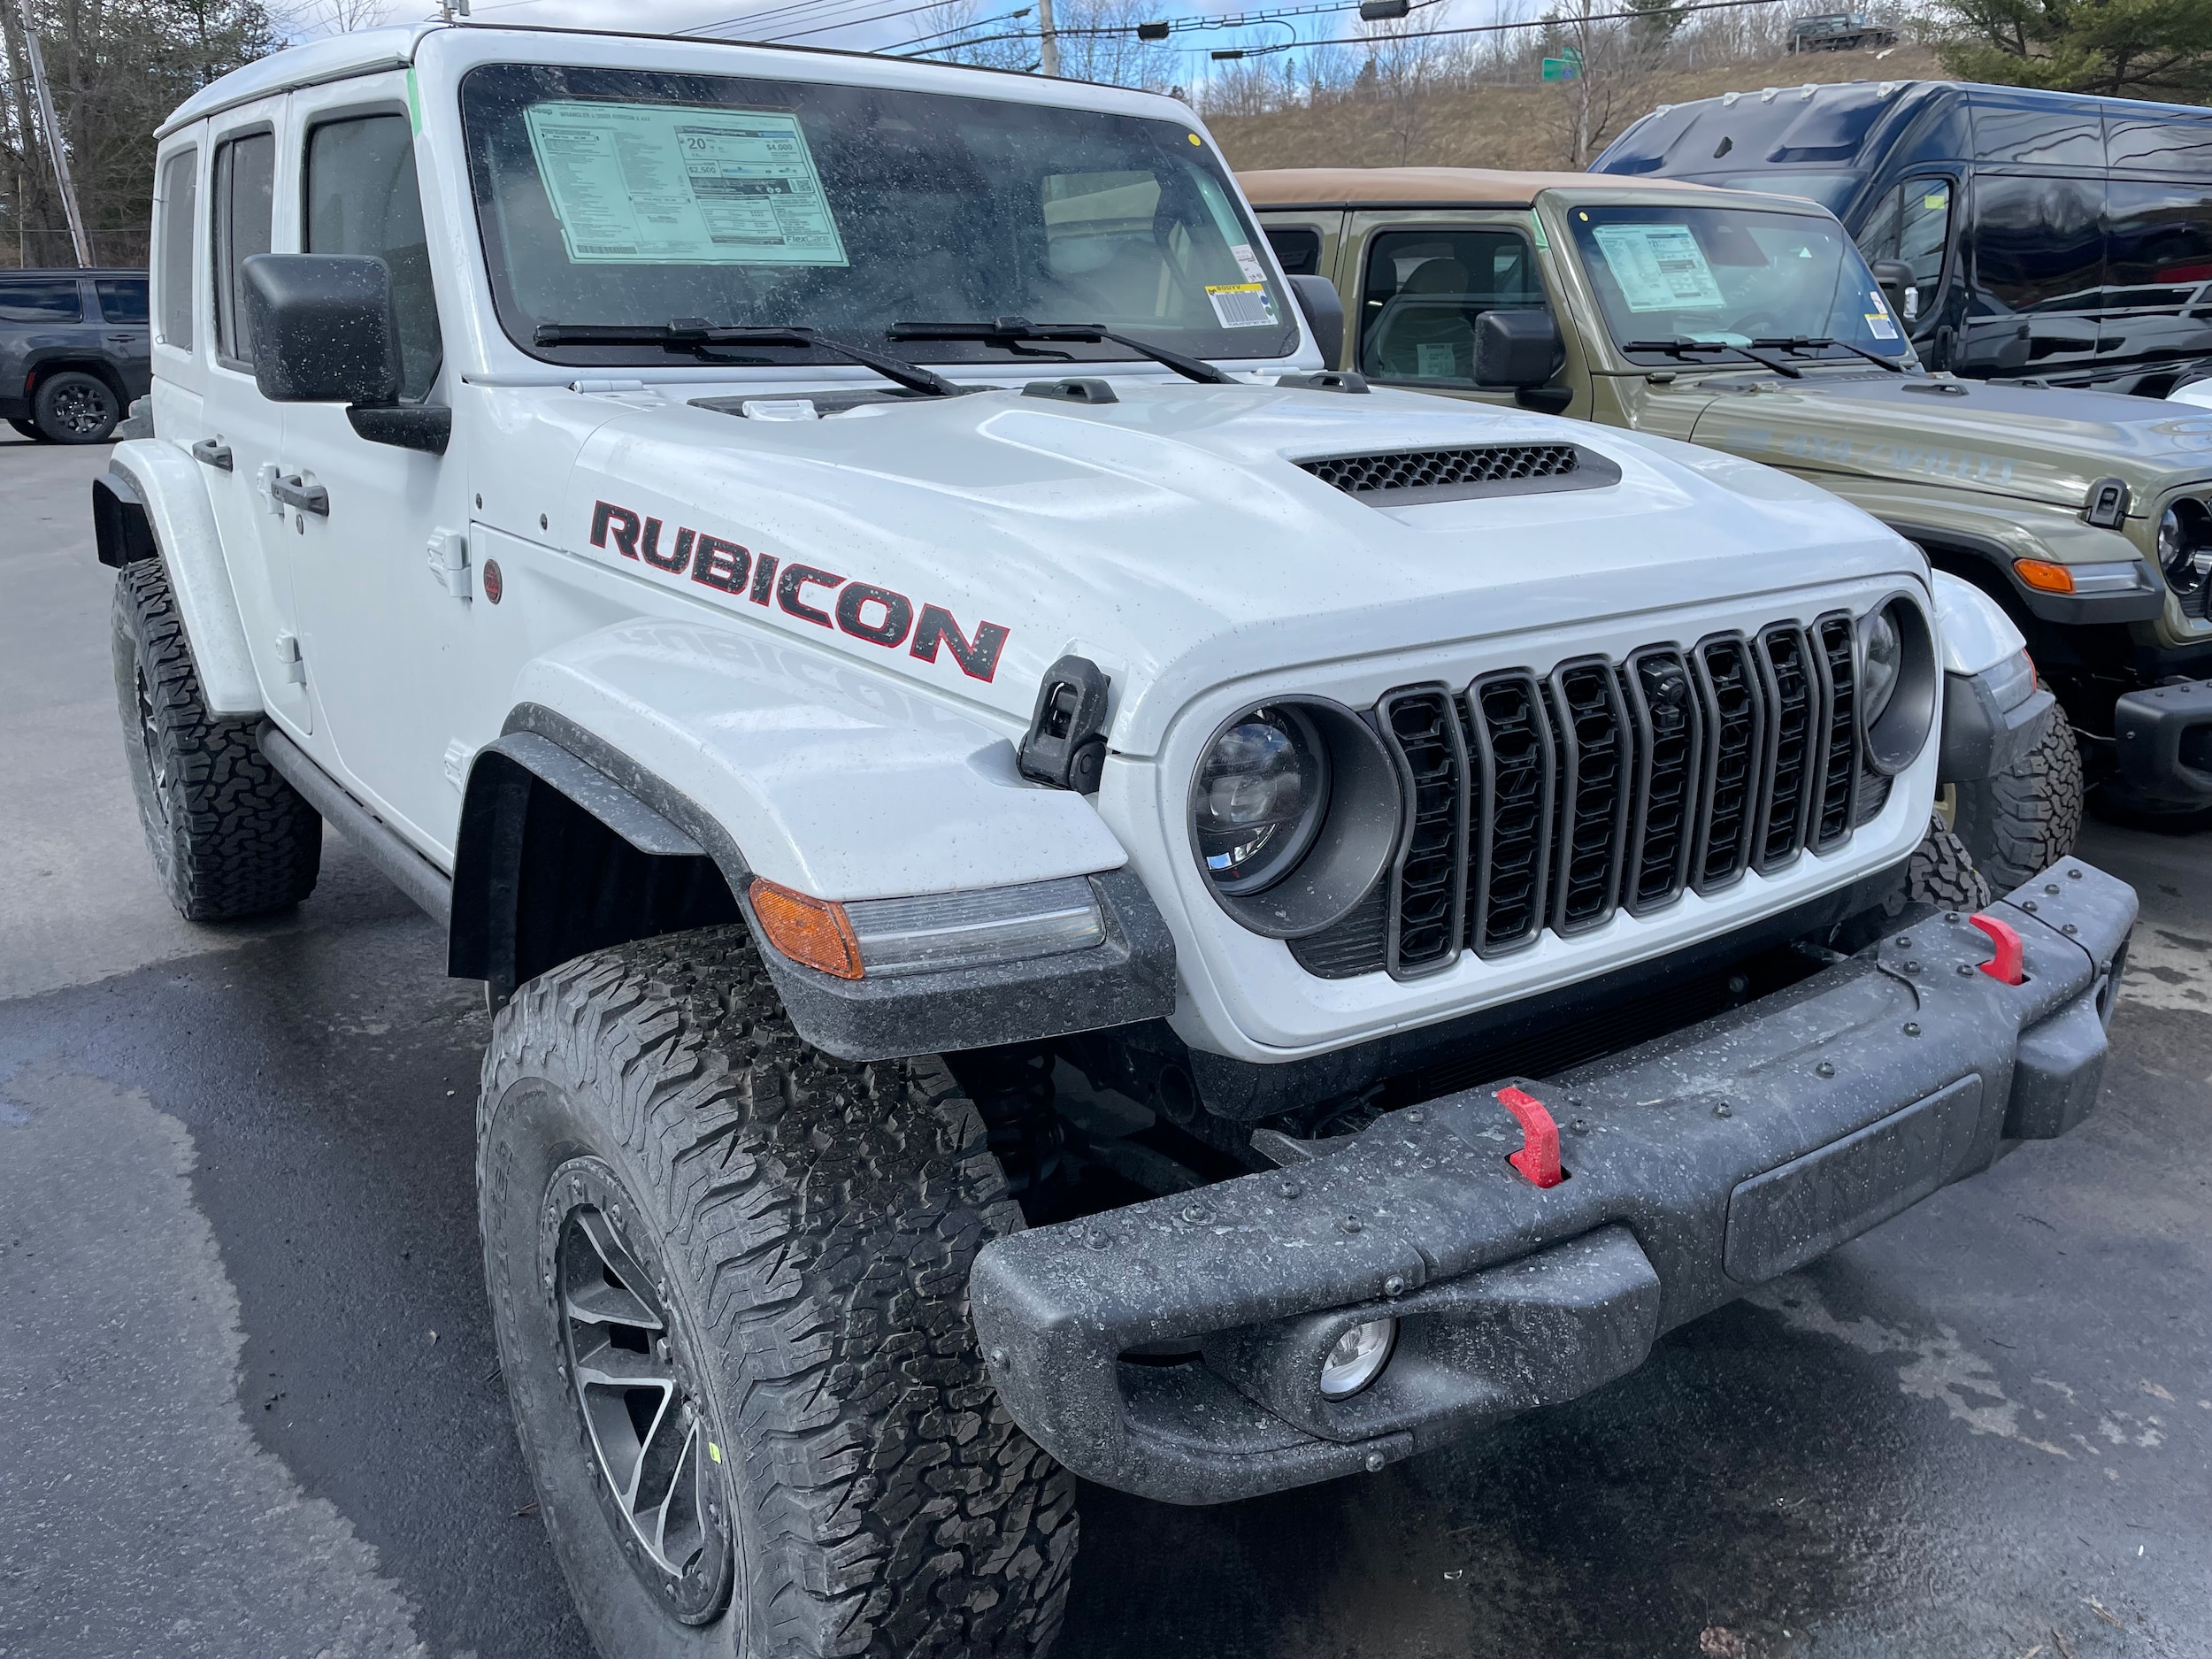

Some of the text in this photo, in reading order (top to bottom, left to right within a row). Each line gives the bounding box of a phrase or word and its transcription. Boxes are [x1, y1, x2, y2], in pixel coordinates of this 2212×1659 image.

[687, 137, 706, 150] 20
[786, 234, 830, 243] FlexCare
[589, 499, 1010, 684] RUBICON
